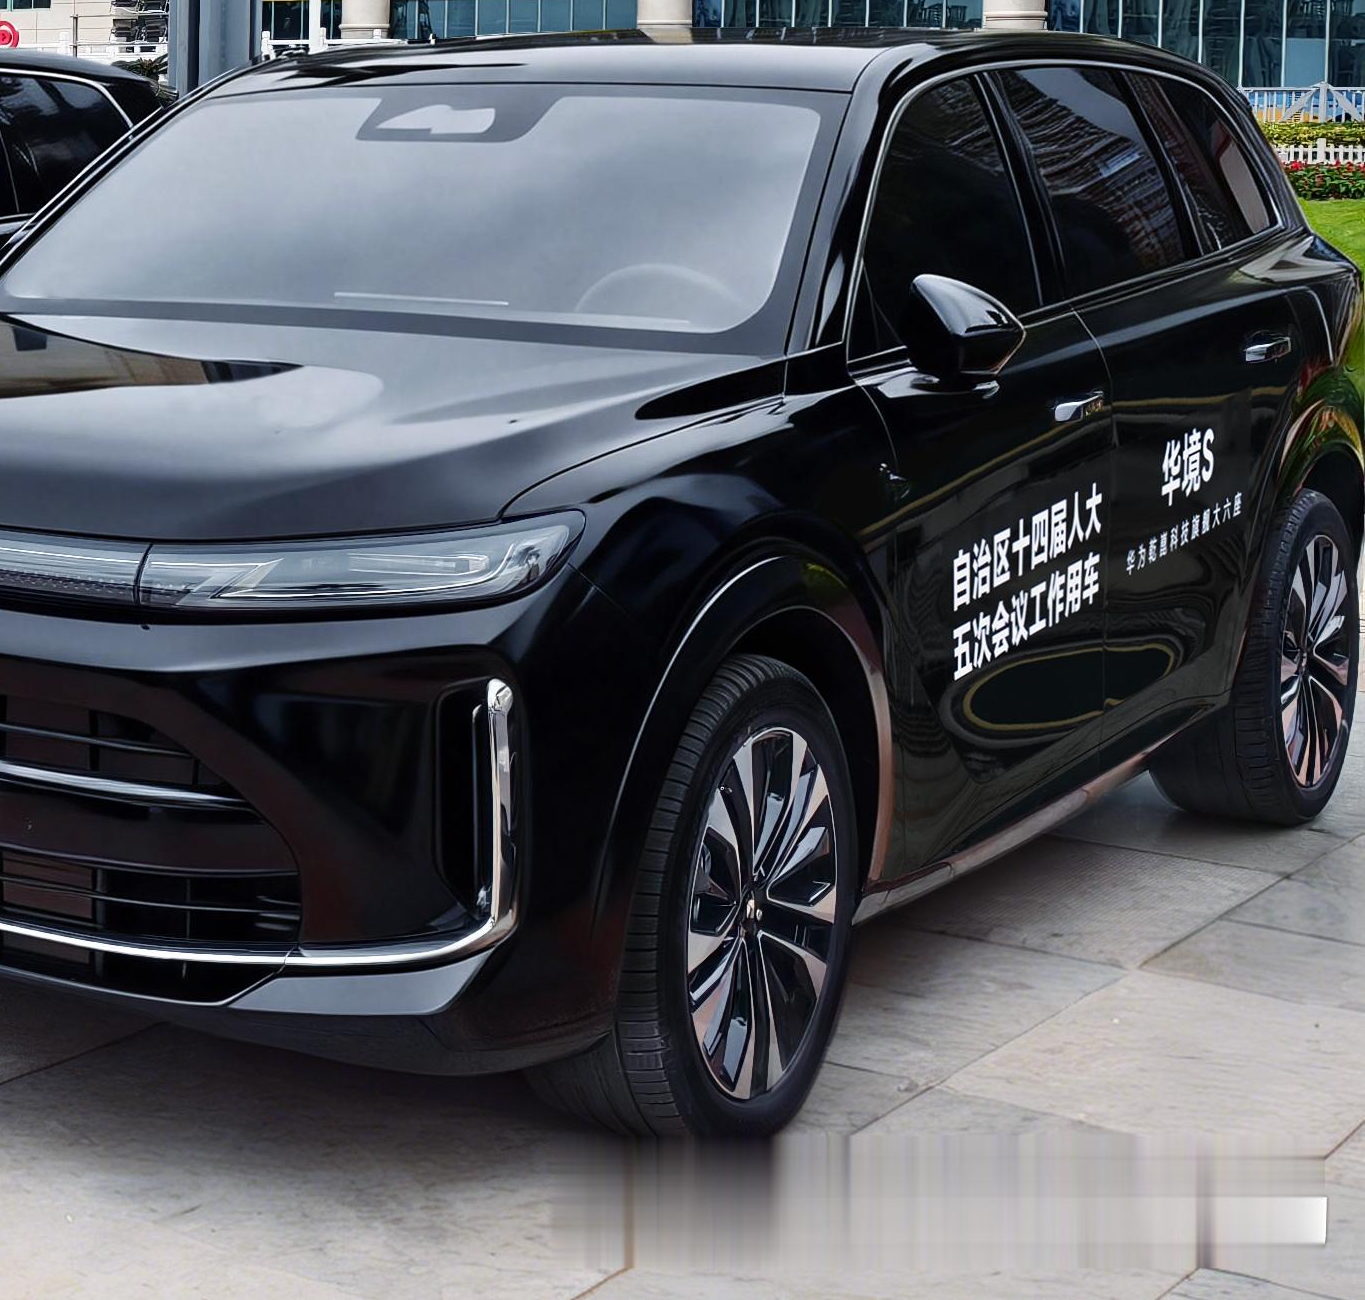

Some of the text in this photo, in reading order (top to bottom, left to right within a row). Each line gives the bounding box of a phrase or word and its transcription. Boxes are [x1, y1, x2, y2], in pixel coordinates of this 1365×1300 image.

[1161, 428, 1215, 506] 华境S
[953, 482, 1102, 611] 自治区十四届人大
[953, 552, 1100, 681] 五次会议工作用车
